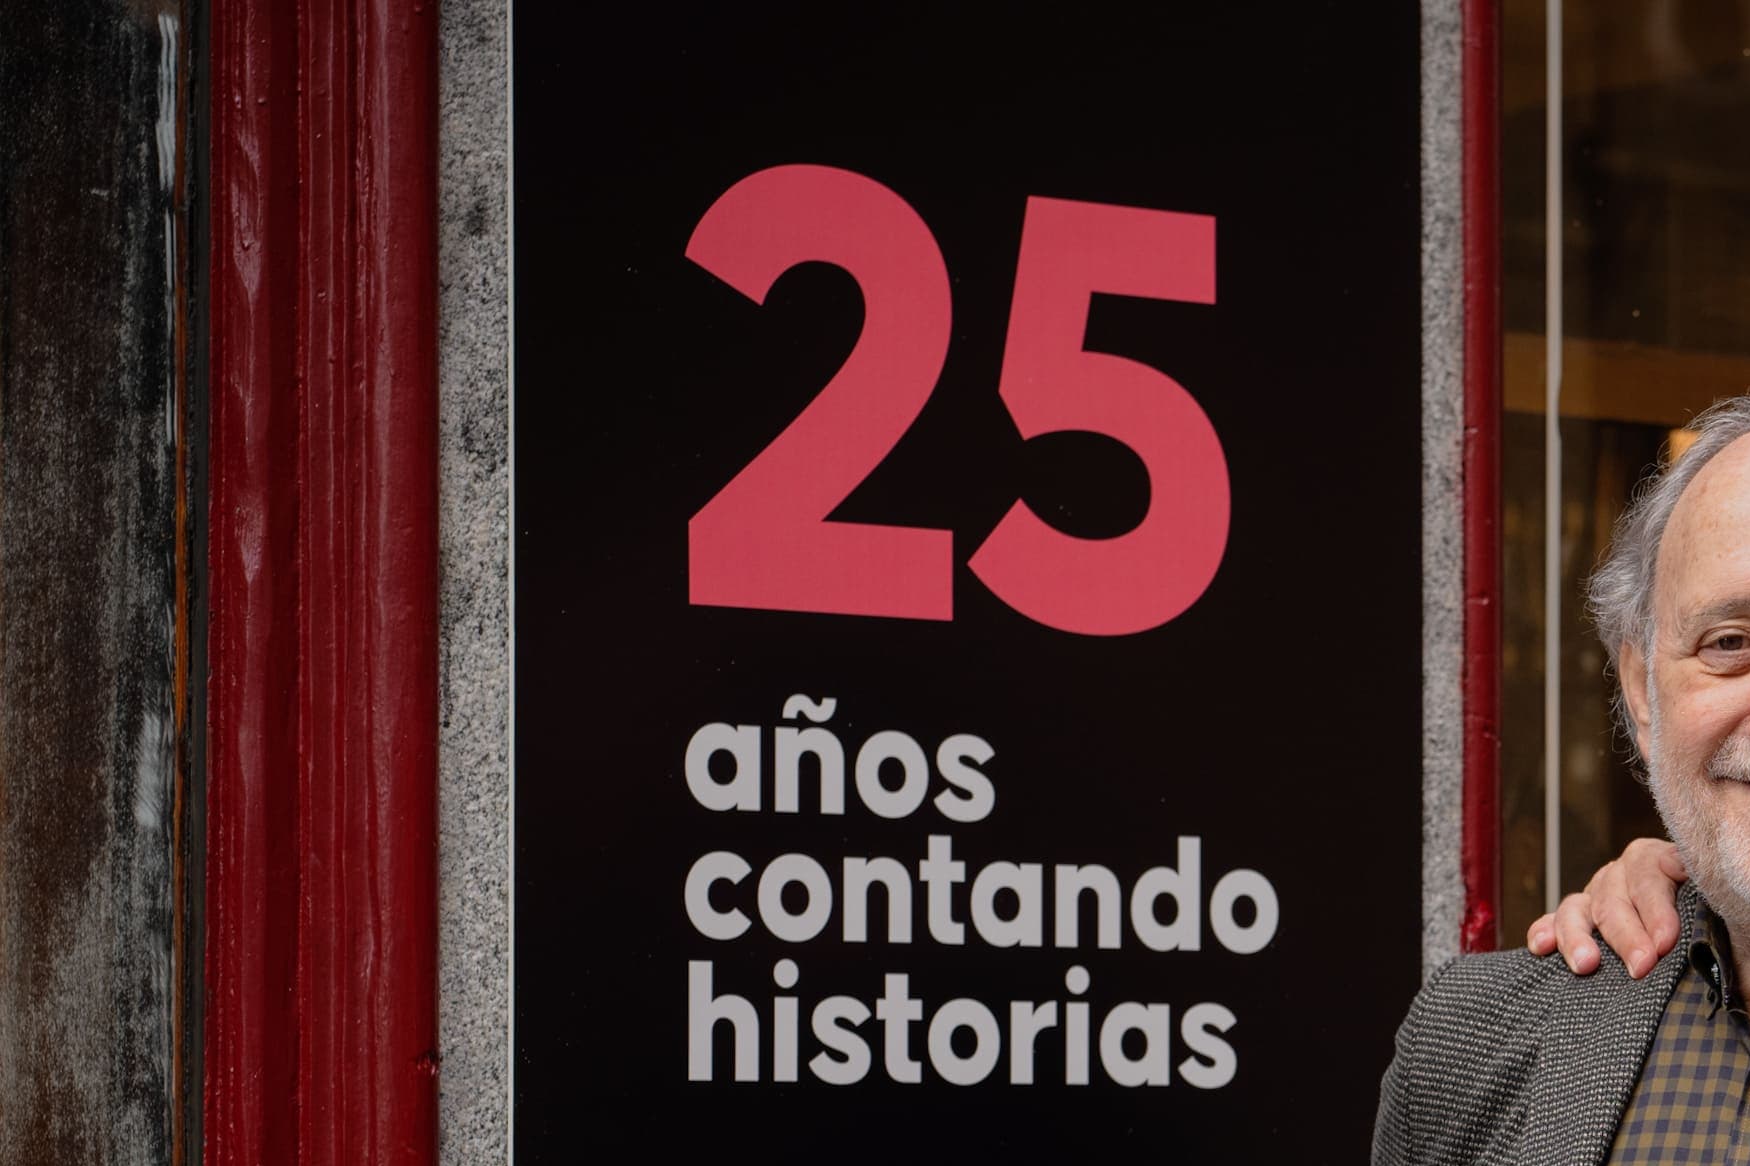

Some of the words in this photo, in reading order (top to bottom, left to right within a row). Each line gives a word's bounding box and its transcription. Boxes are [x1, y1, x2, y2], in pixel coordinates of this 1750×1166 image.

[685, 164, 1231, 636] 25
[685, 695, 995, 822] años
[685, 836, 1279, 954] contando
[688, 959, 1237, 1089] historias
